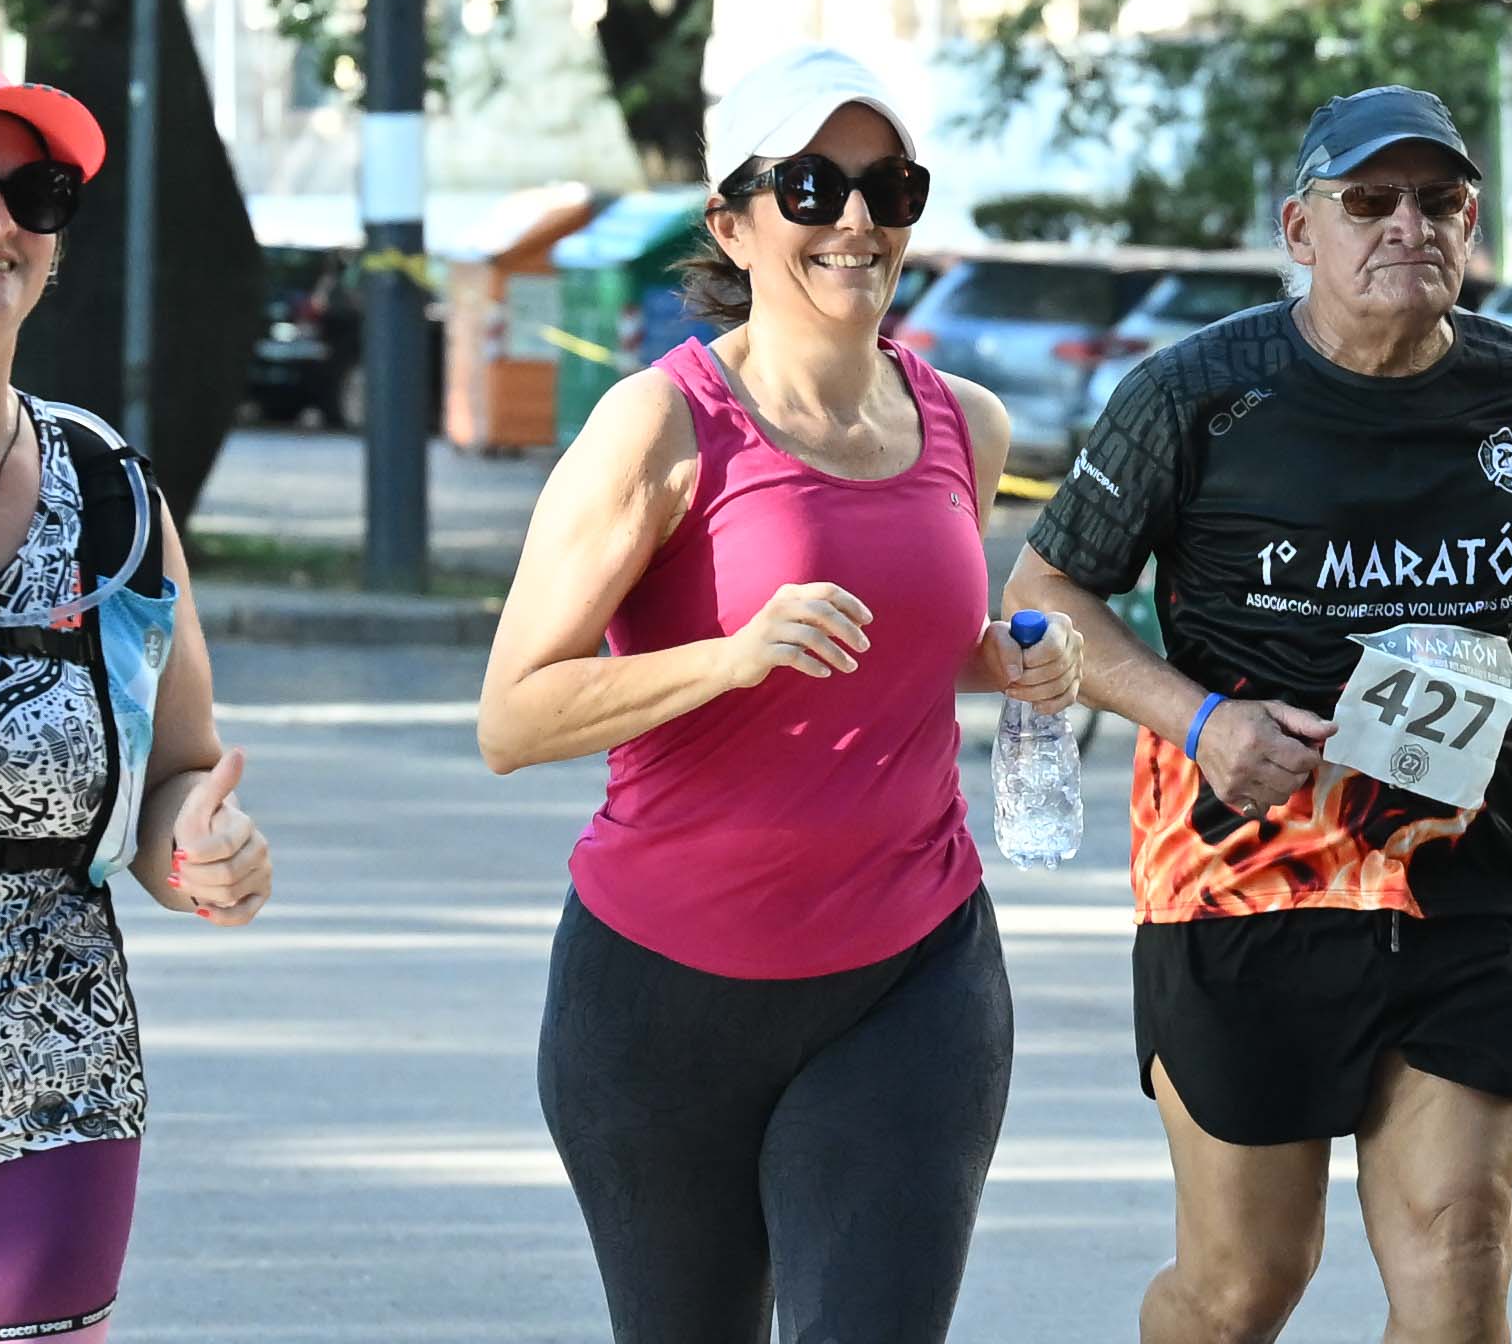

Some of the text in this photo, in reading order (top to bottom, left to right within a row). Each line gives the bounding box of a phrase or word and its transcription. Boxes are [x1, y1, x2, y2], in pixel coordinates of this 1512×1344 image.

[1246, 592, 1322, 618] ASOCIACIÓN
[1326, 601, 1404, 618] BOMBEROS
[1405, 633, 1497, 667] MARATÓN
[1361, 669, 1497, 750] 427
[0, 1325, 38, 1339] COCOT
[40, 1319, 73, 1334] SPORT
